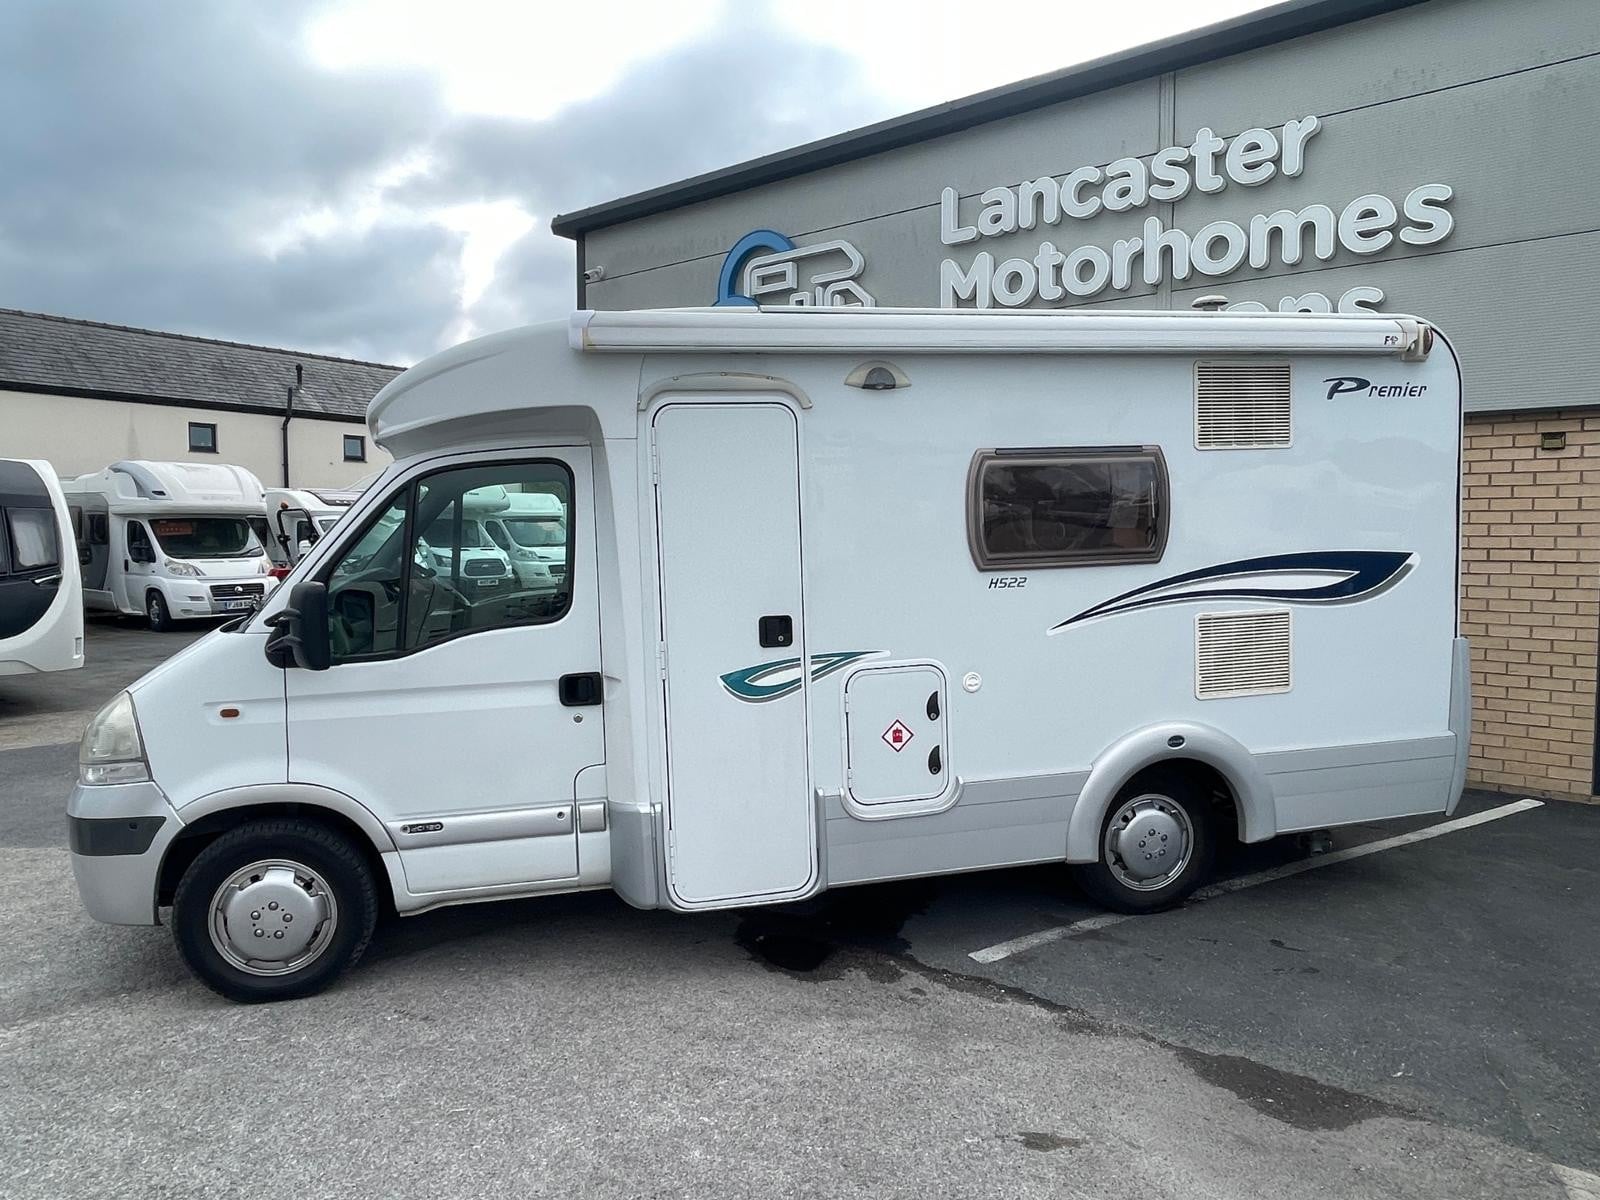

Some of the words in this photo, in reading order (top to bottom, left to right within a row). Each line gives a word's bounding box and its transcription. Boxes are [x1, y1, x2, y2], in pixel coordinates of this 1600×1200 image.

[941, 115, 1322, 246] Lancaster
[940, 184, 1455, 309] Motorhomes
[1323, 377, 1427, 400] Premier
[988, 577, 1027, 589] H522
